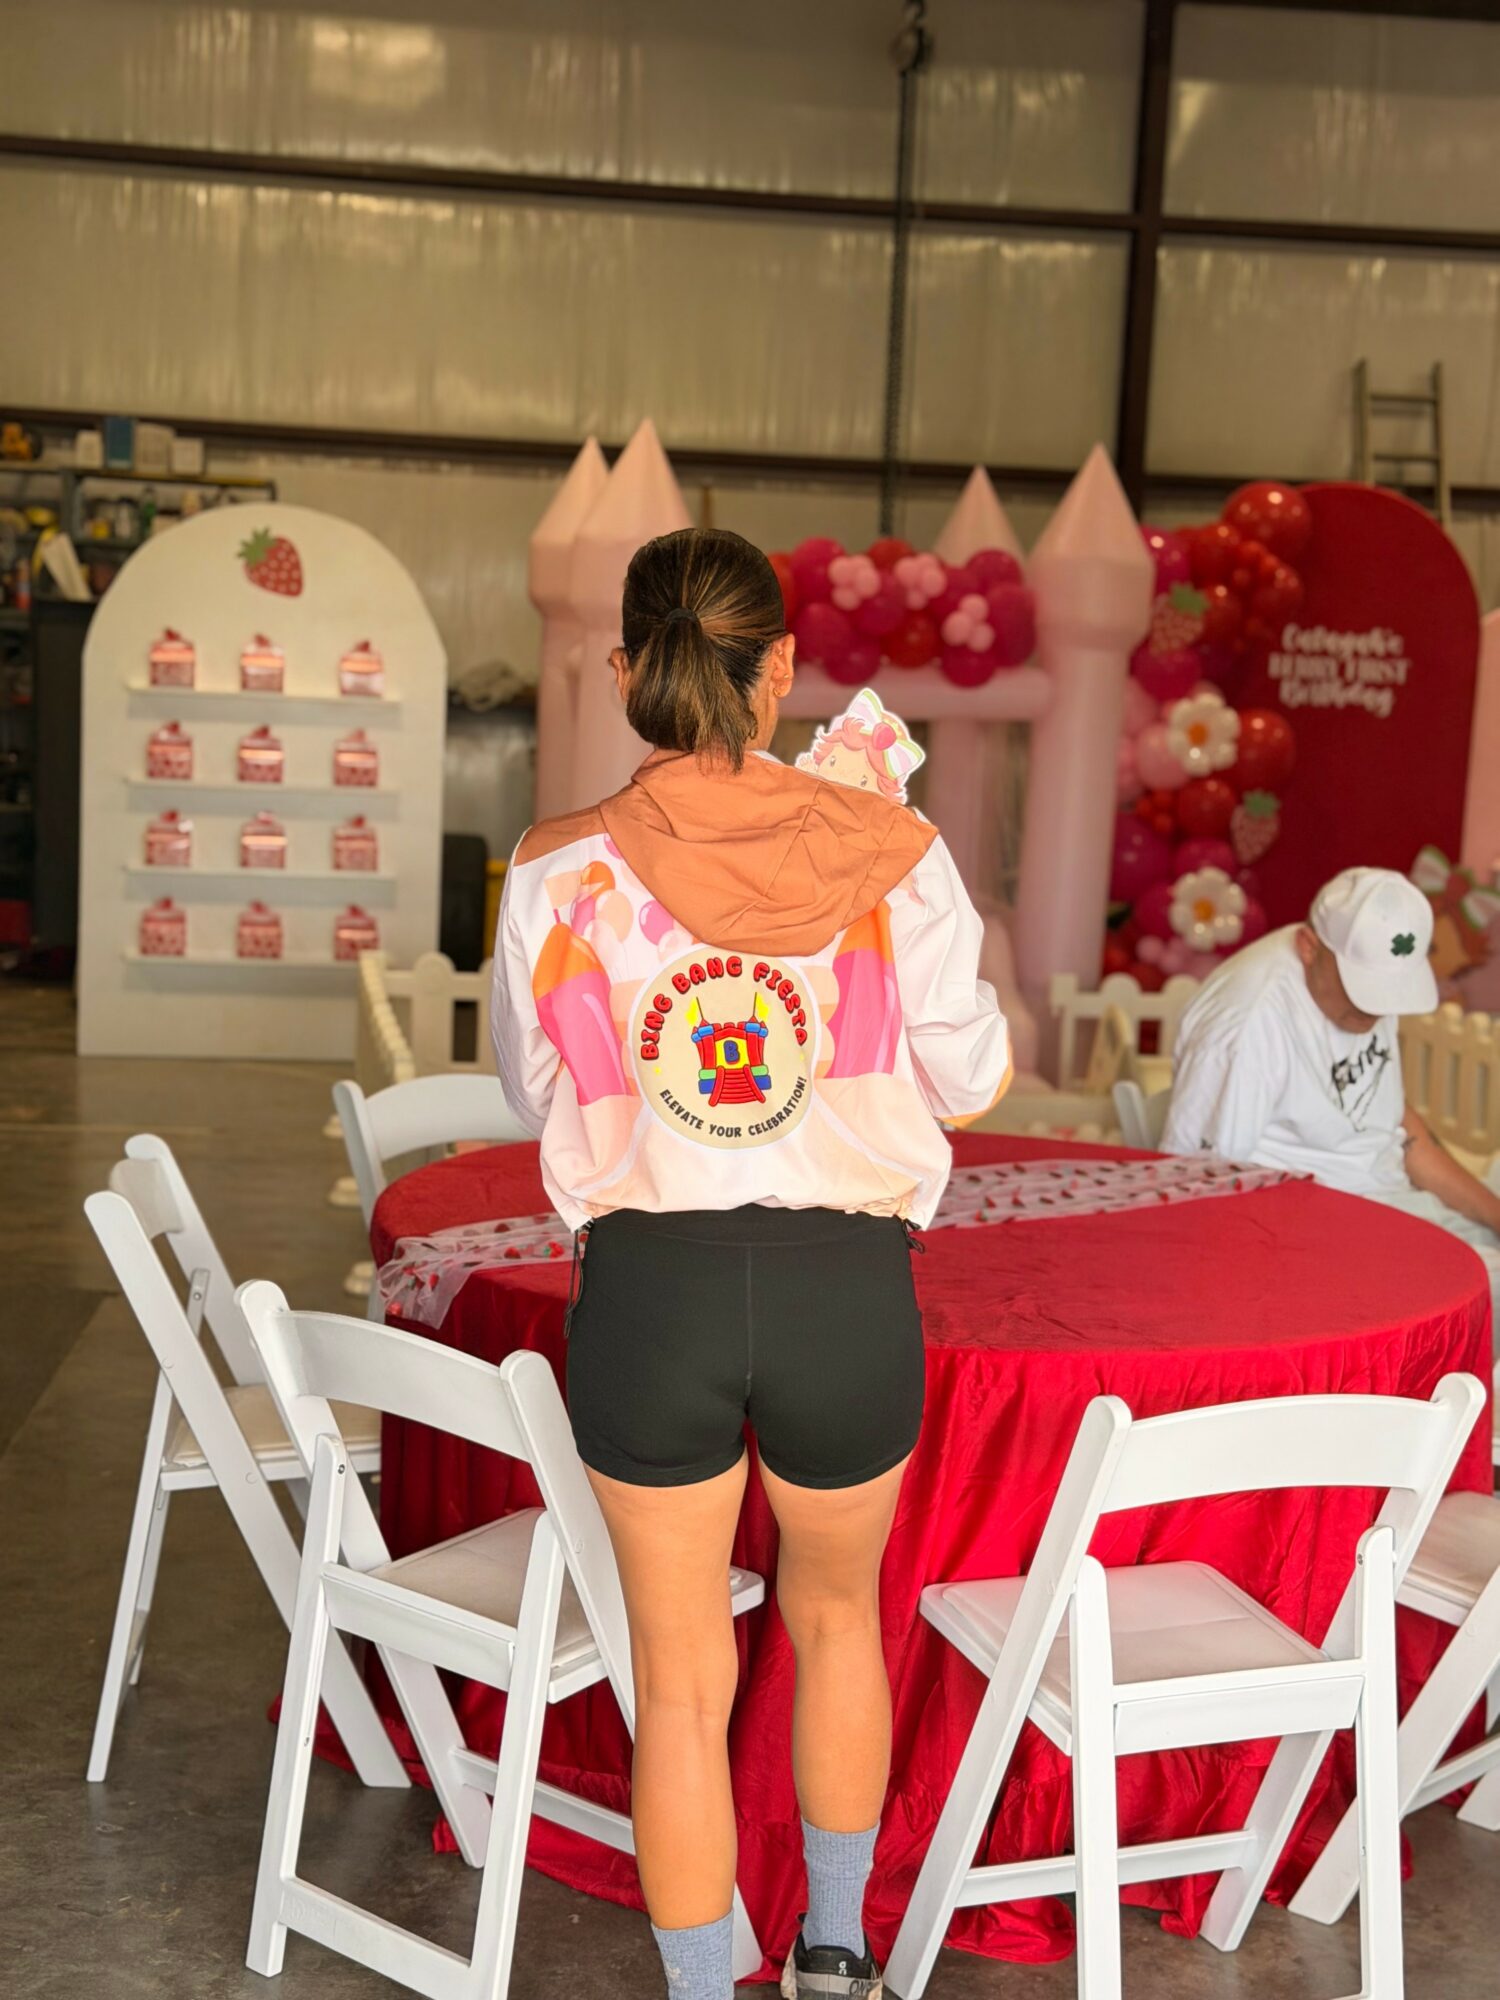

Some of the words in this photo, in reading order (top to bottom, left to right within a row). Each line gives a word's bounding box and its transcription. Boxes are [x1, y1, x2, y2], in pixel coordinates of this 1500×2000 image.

[641, 993, 673, 1060] BING
[672, 956, 742, 995] BANG
[753, 962, 808, 1047] FIESTA
[723, 1040, 741, 1065] B
[660, 1089, 704, 1130] ELEVATE
[709, 1123, 742, 1138] YOUR
[748, 1076, 807, 1136] CELEBRATION!
